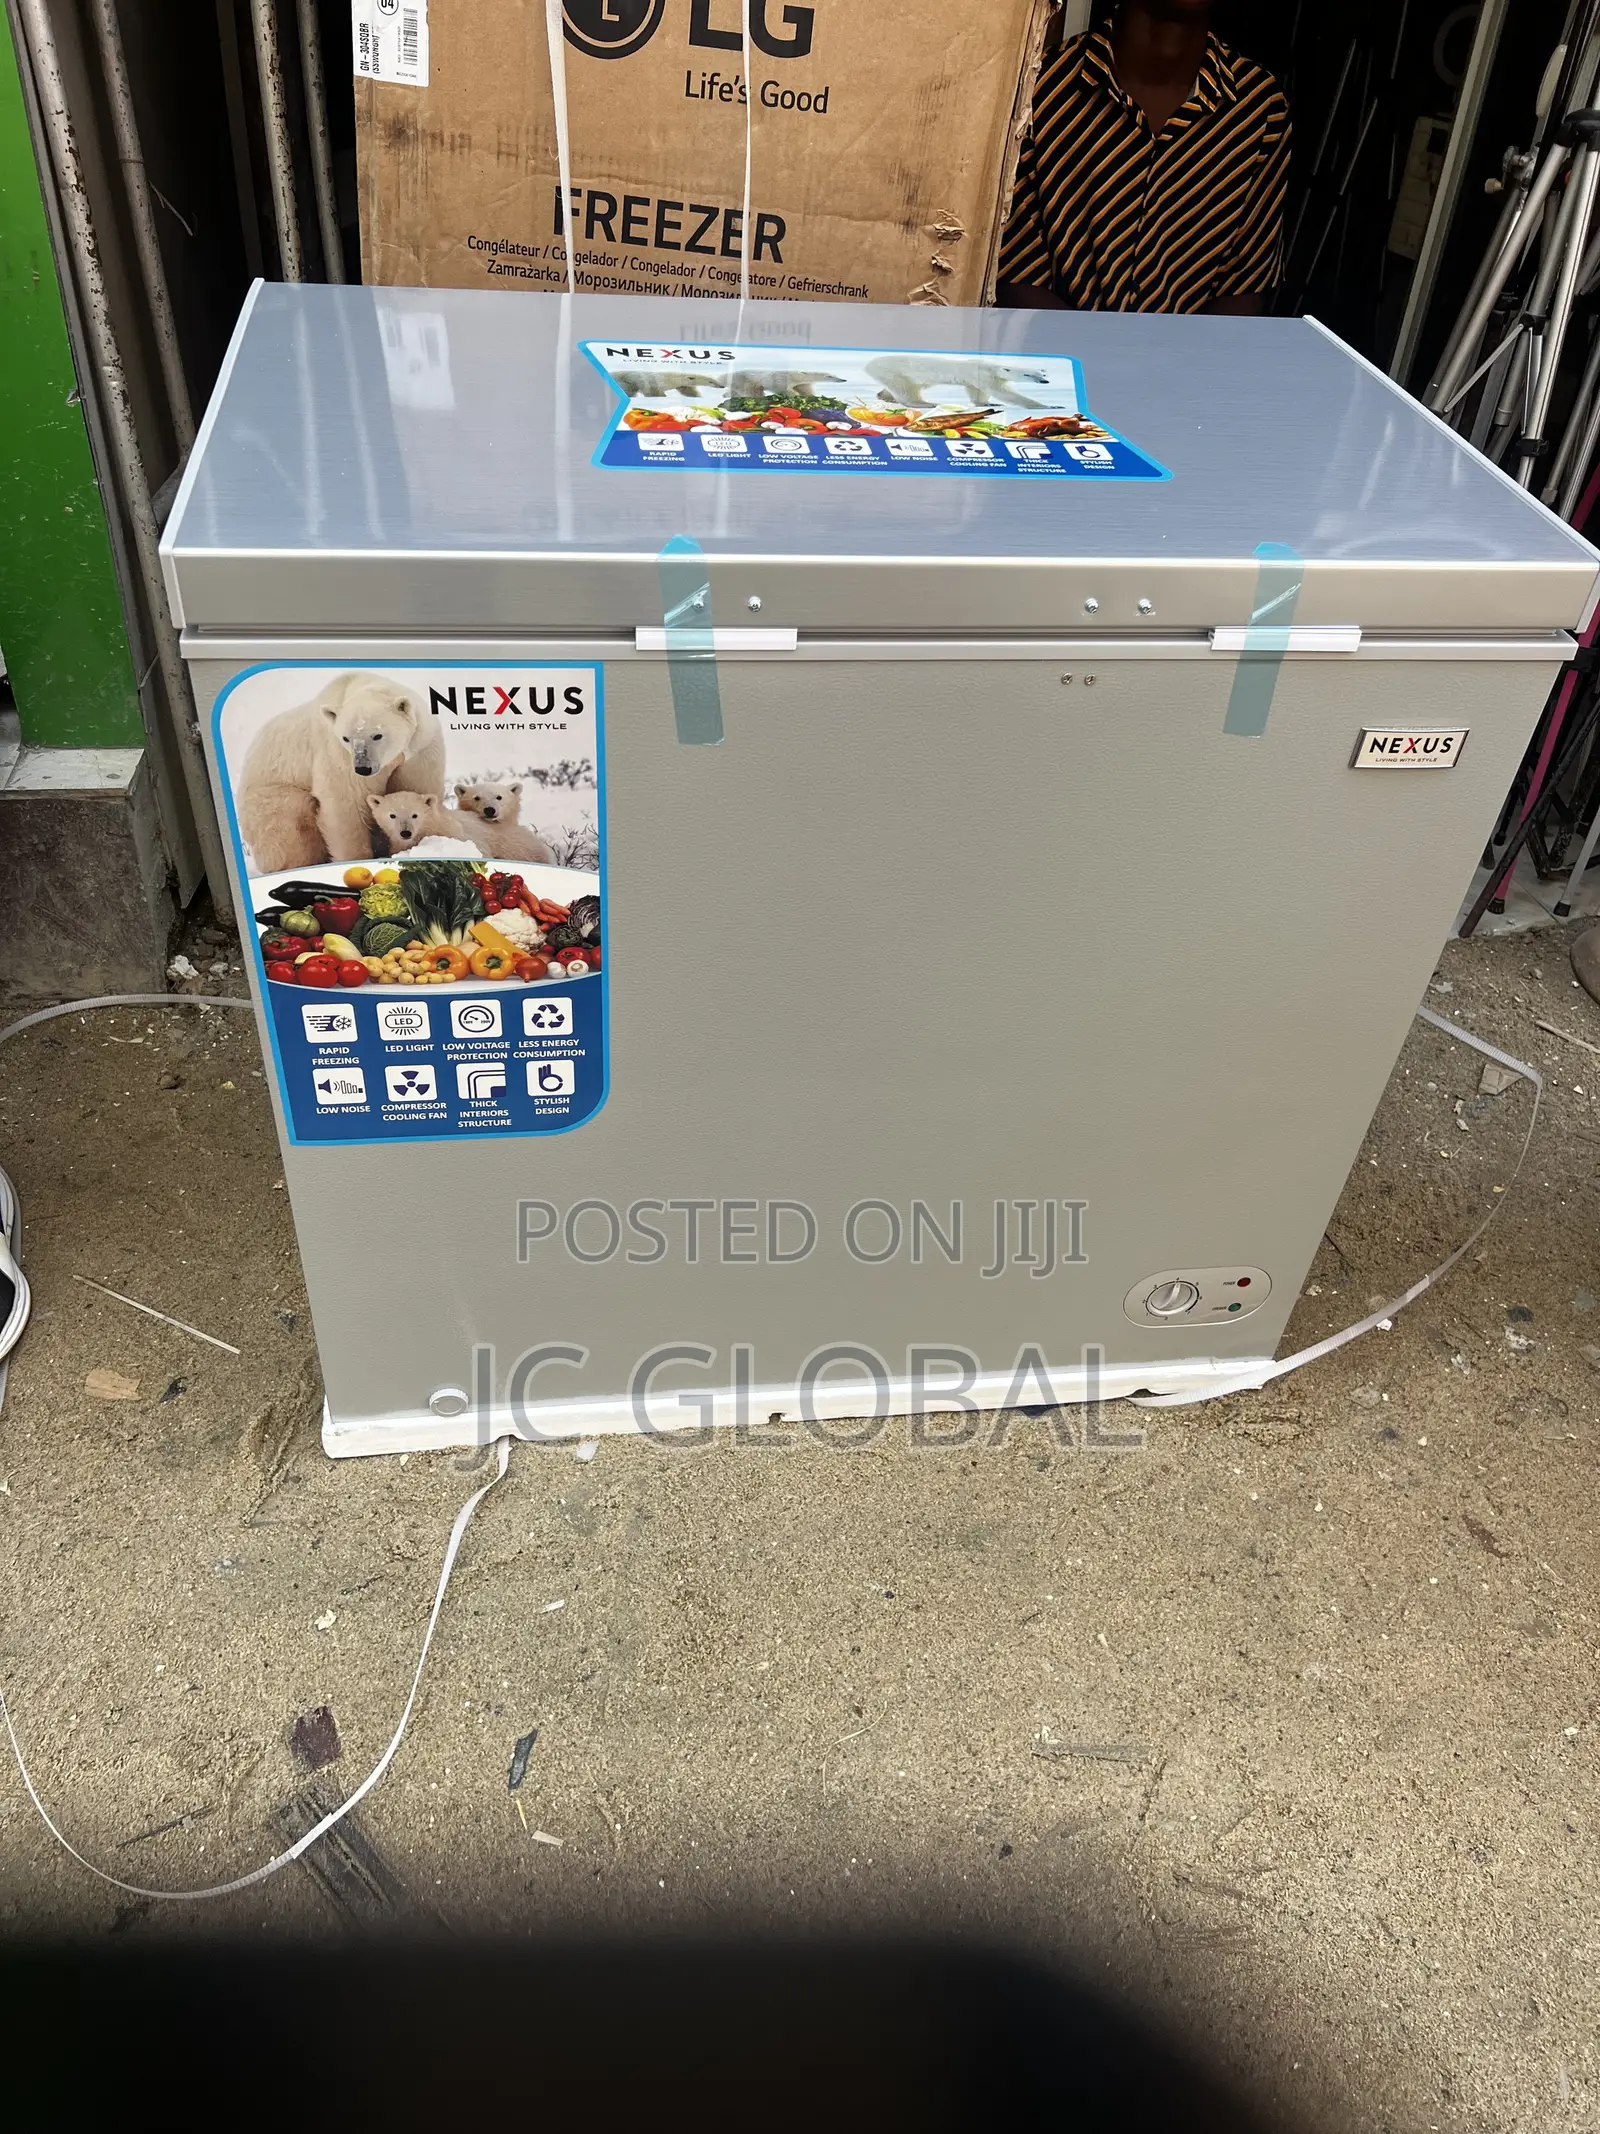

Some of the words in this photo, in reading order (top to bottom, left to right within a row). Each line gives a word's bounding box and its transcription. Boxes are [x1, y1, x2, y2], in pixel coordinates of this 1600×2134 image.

[689, 0, 814, 58] LG
[760, 80, 829, 114] Good
[553, 185, 787, 265] FREEZER
[467, 235, 540, 258] Congélateur
[552, 246, 618, 267] Cogelador
[630, 257, 696, 278] Congelador
[708, 266, 777, 287] Congeatore
[787, 276, 869, 299] Gefrierschrank
[487, 259, 560, 282] Zamrażarka
[574, 271, 670, 297] Морозильник
[606, 347, 735, 360] NEXUS
[429, 686, 584, 715] NEXUS
[1369, 737, 1454, 753] NEXUS
[442, 1043, 465, 1051] LOW
[467, 1041, 511, 1050] VOLTAGE
[518, 1040, 540, 1048] LESS
[541, 1039, 580, 1047] ENERGY
[318, 1047, 350, 1055] RAPID
[385, 1045, 404, 1053] LED
[405, 1044, 435, 1052] LIGHT
[446, 1052, 508, 1061] PROTECTION
[512, 1050, 586, 1059] CONSUMPTION
[312, 1057, 360, 1066] FREEZING
[469, 1100, 498, 1108] THICK
[533, 1097, 570, 1105] STYLISH
[316, 1106, 339, 1114] LOW
[341, 1105, 371, 1113] NOISE
[381, 1102, 447, 1112] COMPRESSOR
[535, 1107, 570, 1115] DESIGN
[382, 1113, 427, 1121] COOLING
[428, 1112, 448, 1120] FAN
[459, 1109, 509, 1118] INTERIORS
[457, 1118, 512, 1128] STRUCTURE
